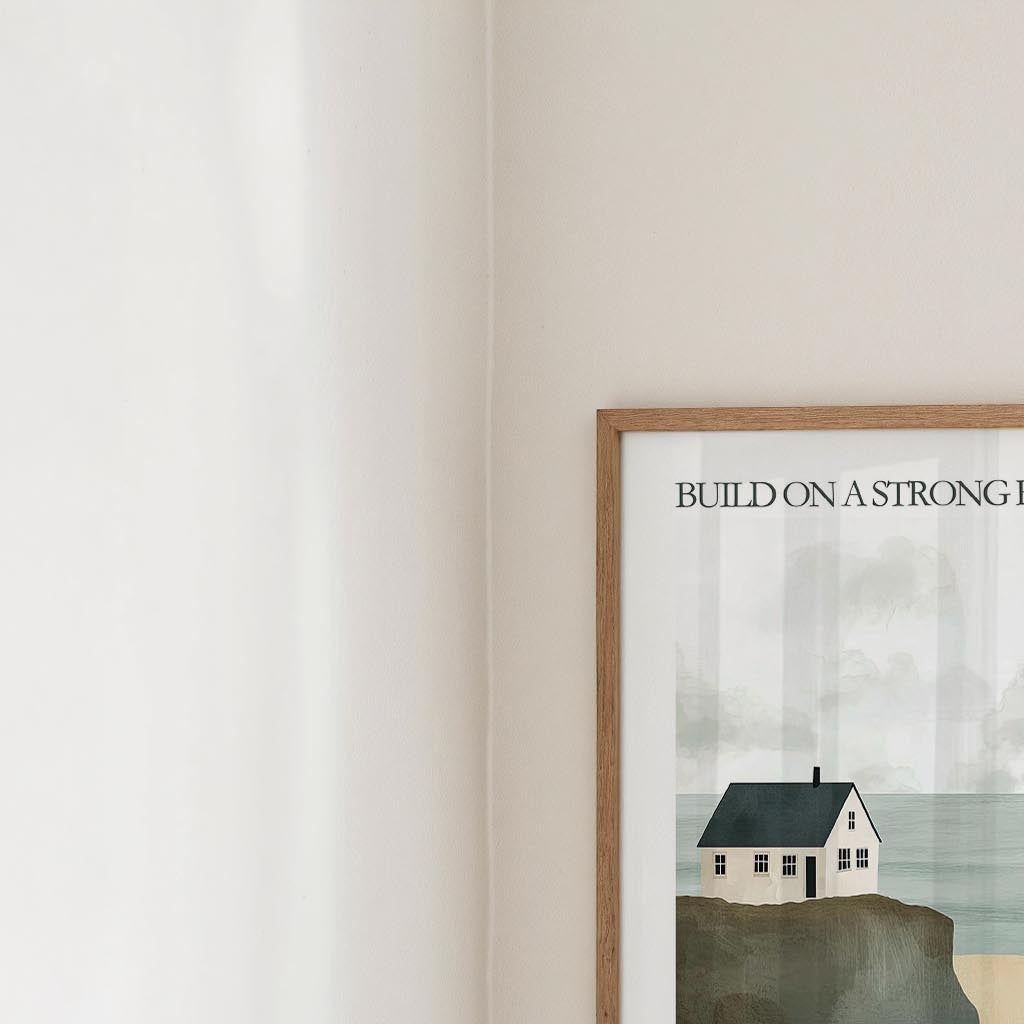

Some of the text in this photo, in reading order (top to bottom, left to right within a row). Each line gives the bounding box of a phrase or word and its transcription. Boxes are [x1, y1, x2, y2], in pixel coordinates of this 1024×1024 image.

[675, 482, 776, 508] BUILD
[783, 481, 836, 508] ON
[841, 480, 868, 506] A
[872, 480, 1011, 507] STRONG
